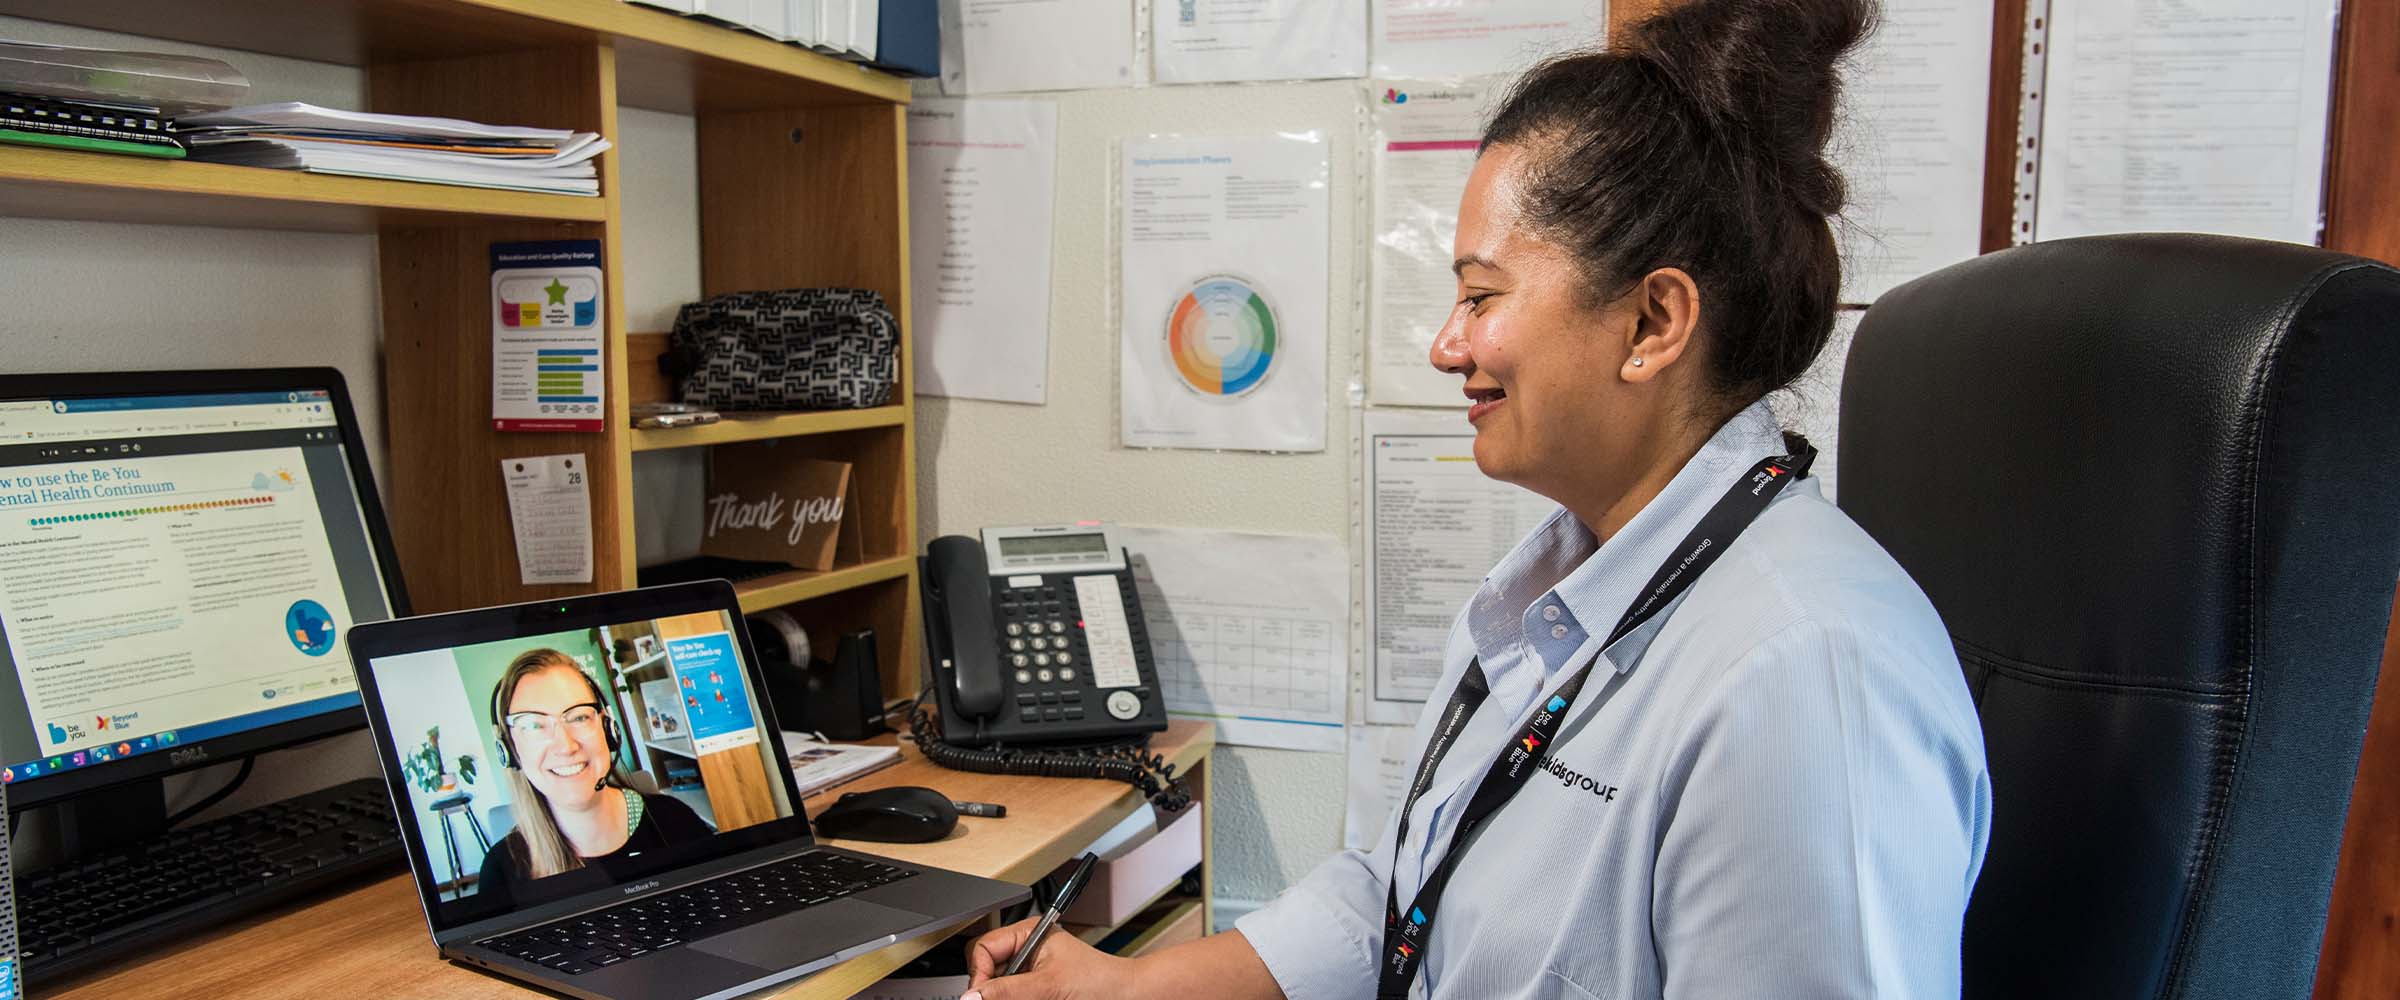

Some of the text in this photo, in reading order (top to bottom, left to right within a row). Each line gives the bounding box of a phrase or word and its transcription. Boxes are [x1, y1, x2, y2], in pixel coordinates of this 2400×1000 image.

[16, 475, 32, 488] to
[36, 475, 61, 487] use
[65, 470, 89, 485] the
[92, 468, 111, 482] Be
[112, 466, 141, 480] You
[568, 472, 582, 485] 28
[1752, 475, 1774, 496] Beyond
[41, 486, 91, 503] Health
[94, 481, 176, 498] Continuum
[708, 492, 844, 546] Thank you
[1684, 538, 1712, 565] Growing
[1655, 568, 1682, 596] mentally
[1634, 594, 1658, 617] healthy
[112, 712, 138, 722] Beyond
[1534, 709, 1548, 726] you
[1541, 713, 1553, 726] be
[67, 725, 80, 733] be
[69, 730, 86, 741] you
[1508, 746, 1523, 763] Blue
[1508, 751, 1530, 778] Beyond
[624, 880, 660, 895] MacBook Pro
[1404, 920, 1415, 936] you
